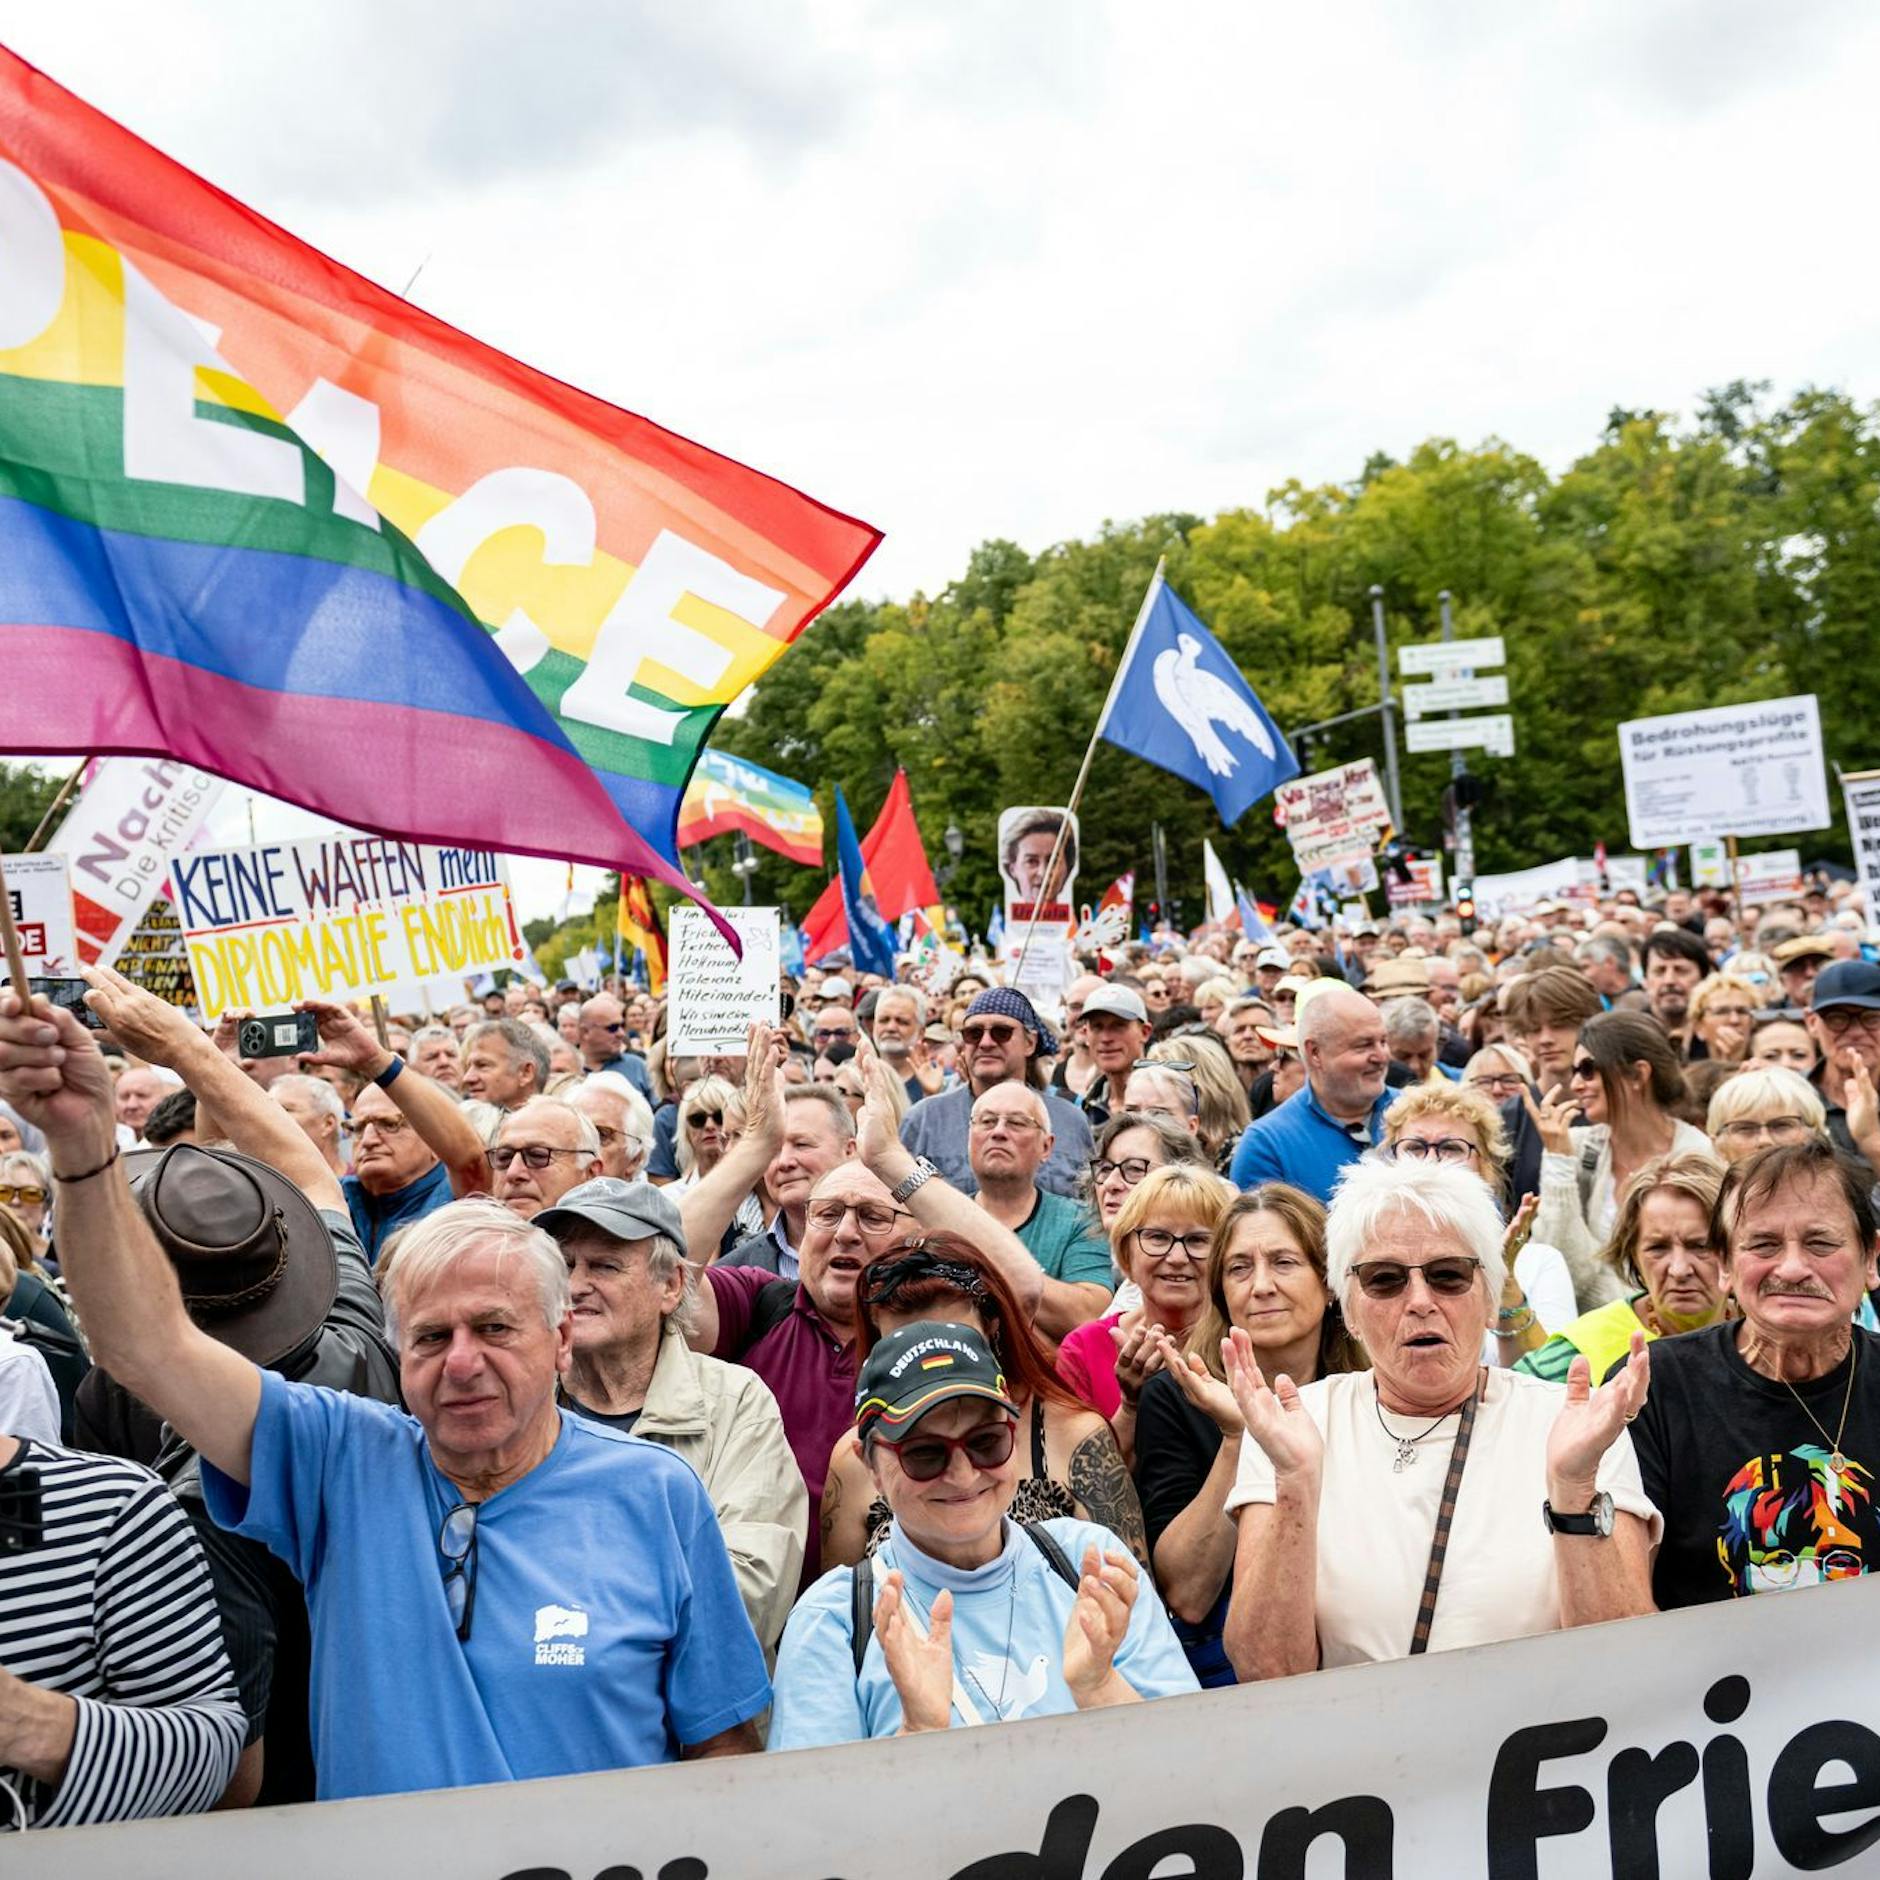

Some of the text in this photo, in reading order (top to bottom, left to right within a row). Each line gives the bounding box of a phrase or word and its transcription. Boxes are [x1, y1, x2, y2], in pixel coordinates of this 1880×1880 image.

[115, 855, 157, 901] Die
[172, 847, 295, 928] KEINE
[292, 837, 426, 910] WAFFEN
[189, 912, 397, 1020] DIPLOMATIE
[676, 972, 742, 984] Toleranz
[889, 1337, 980, 1379] DEUTSCHLAND
[535, 1643, 575, 1654] CLIFFS
[535, 1653, 585, 1665] MOHER
